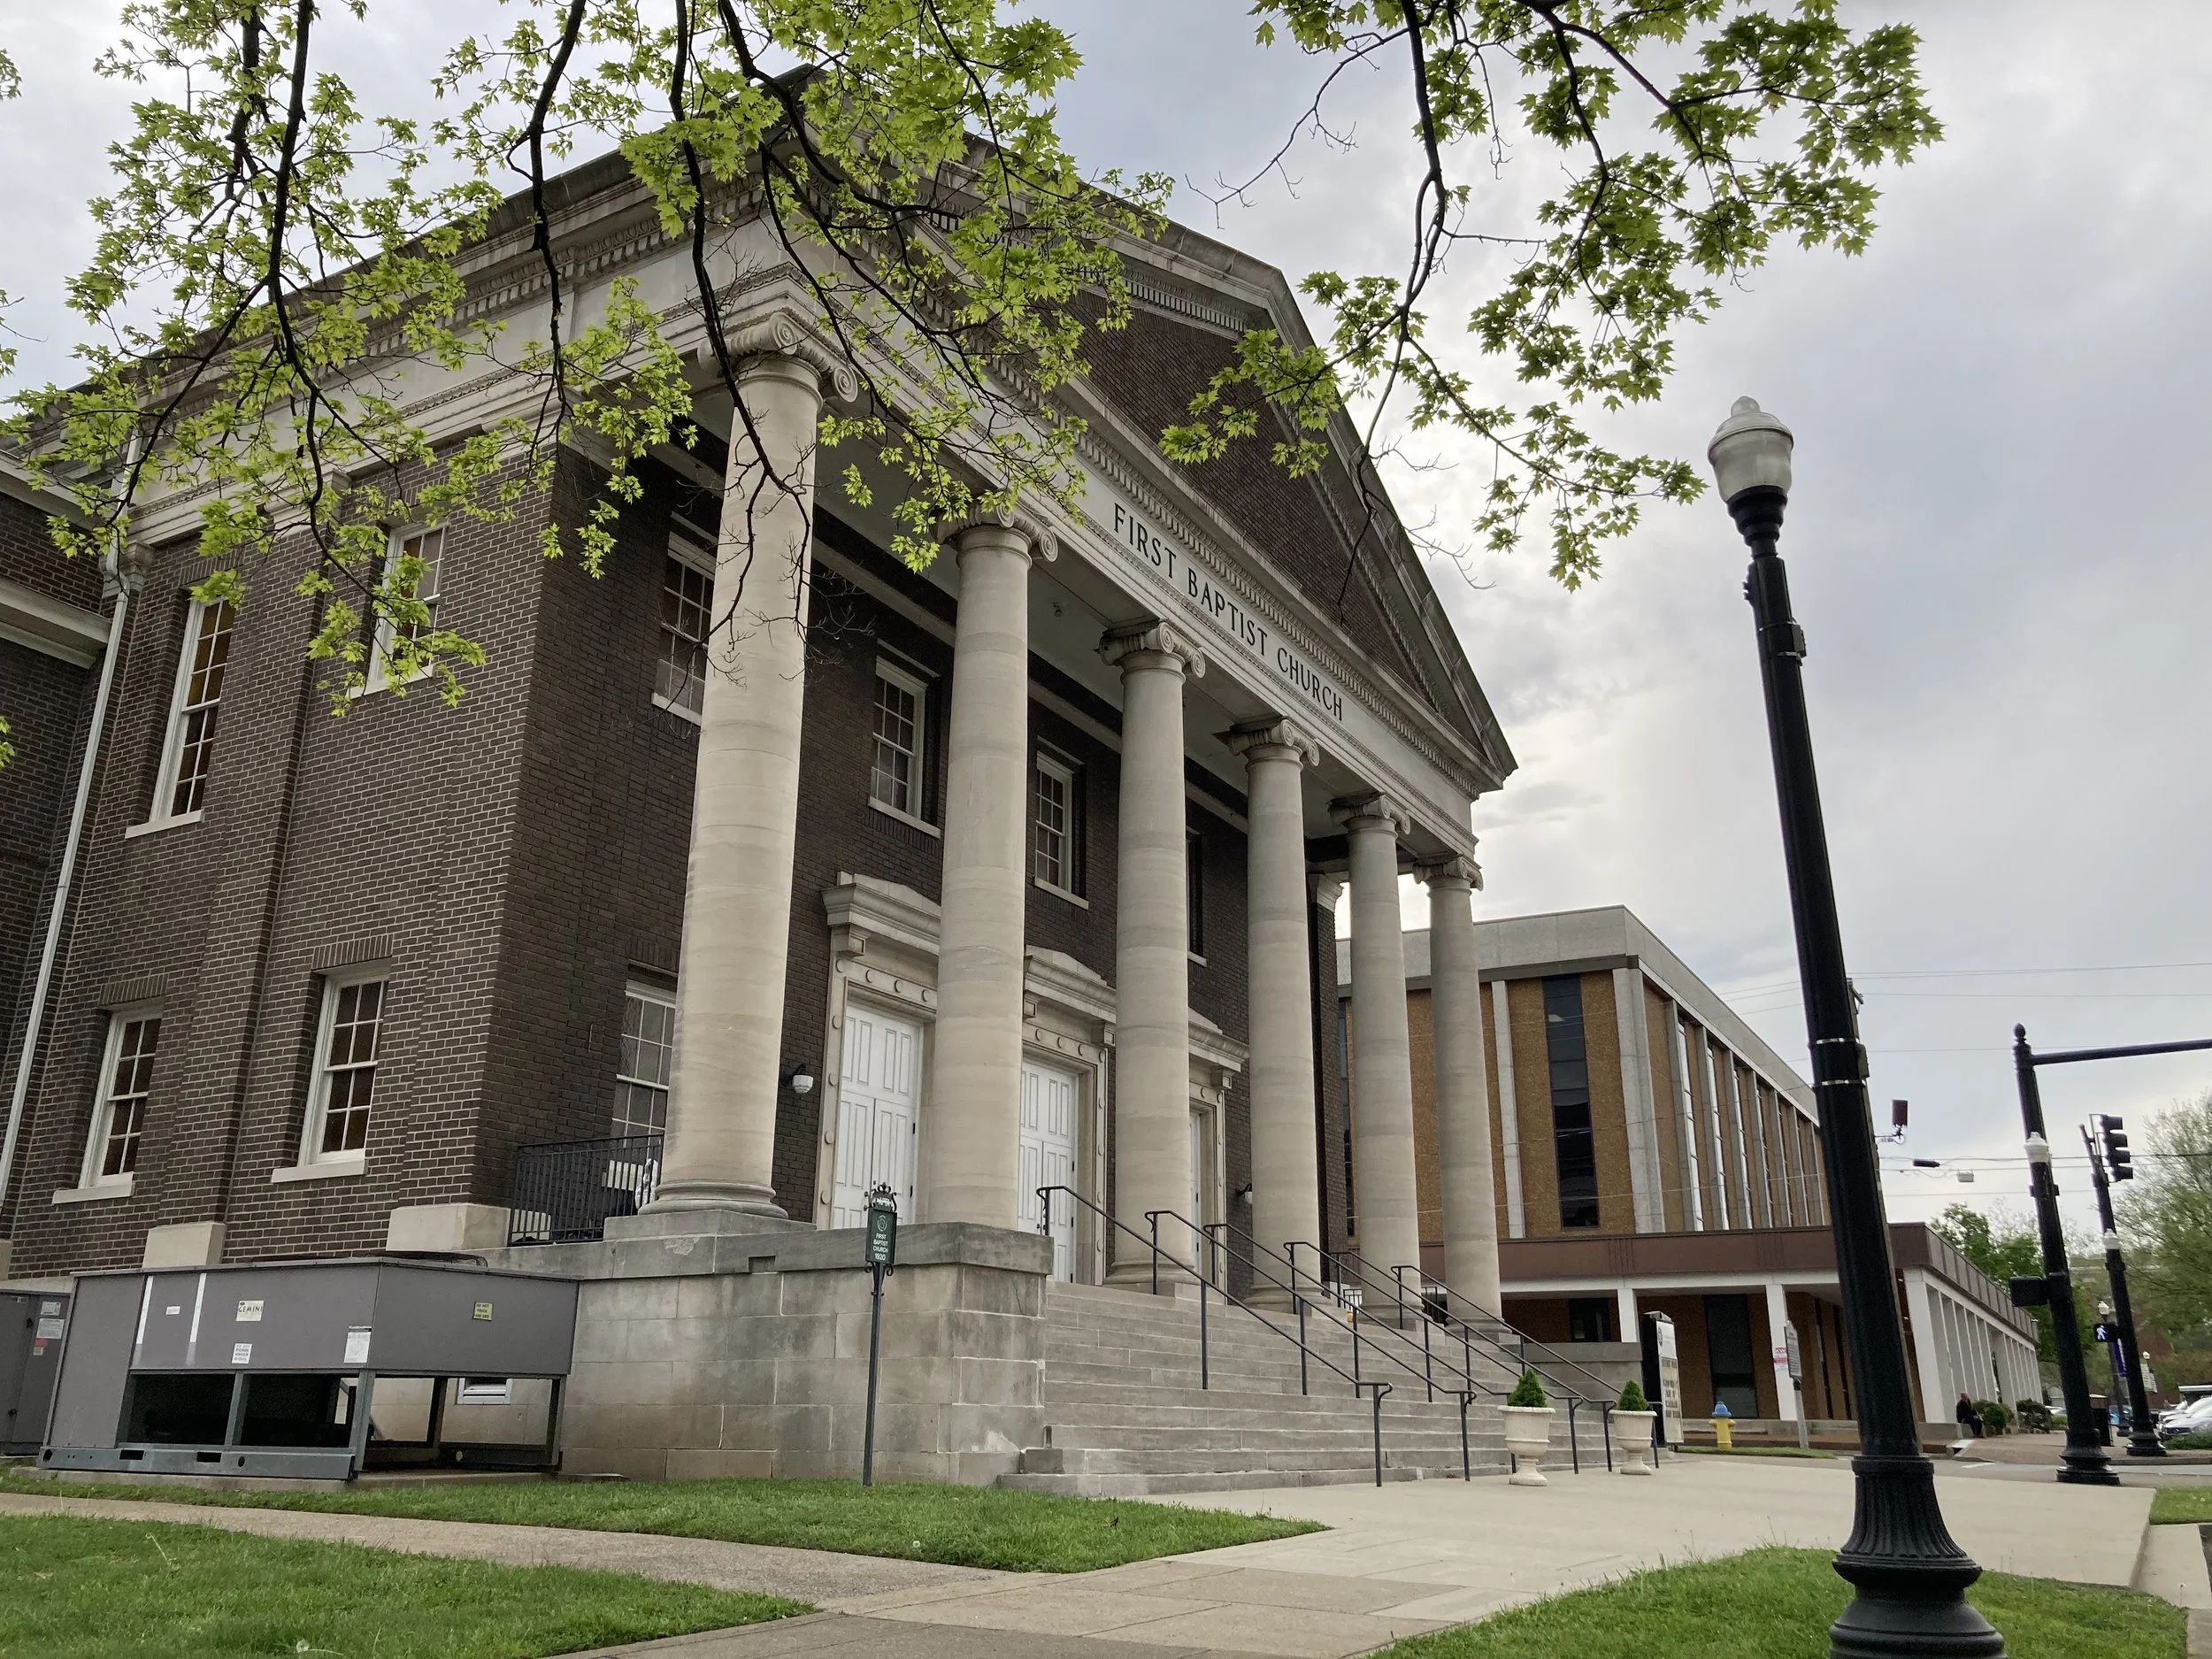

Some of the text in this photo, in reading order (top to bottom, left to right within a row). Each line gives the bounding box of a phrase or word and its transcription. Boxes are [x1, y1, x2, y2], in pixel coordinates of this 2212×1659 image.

[1113, 503, 1343, 721] FIRST BAPTIST CHURCH
